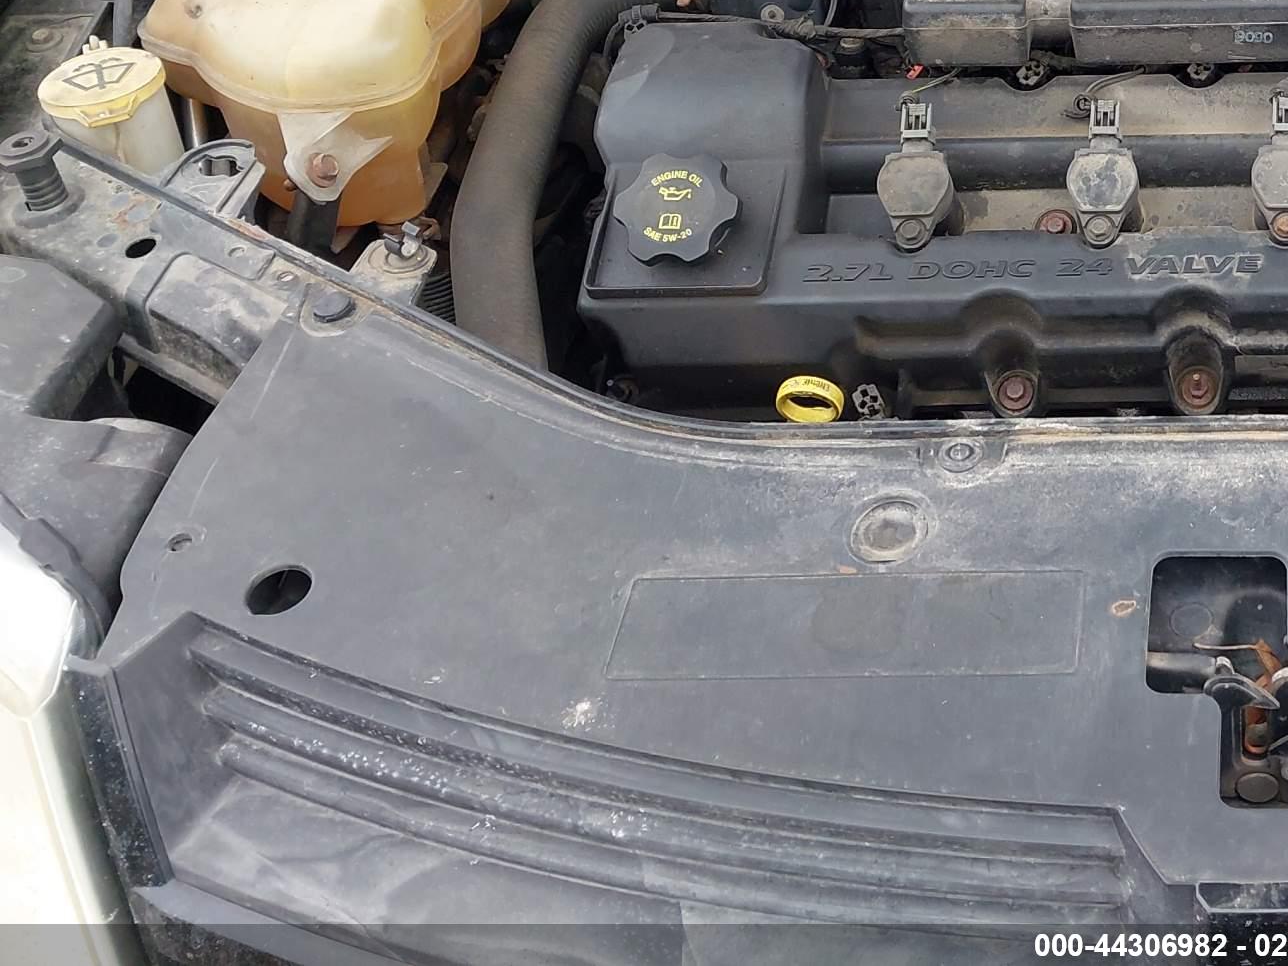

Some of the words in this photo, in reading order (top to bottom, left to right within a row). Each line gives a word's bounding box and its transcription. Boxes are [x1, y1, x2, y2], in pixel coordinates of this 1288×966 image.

[651, 170, 688, 186] ENGINE
[689, 174, 703, 187] OIL
[643, 227, 662, 241] SAE
[663, 228, 692, 242] 5W-20
[803, 264, 894, 282] 2.7L
[906, 260, 1036, 279] DOHC
[1056, 258, 1113, 276] 24
[1125, 254, 1263, 275] VALVE
